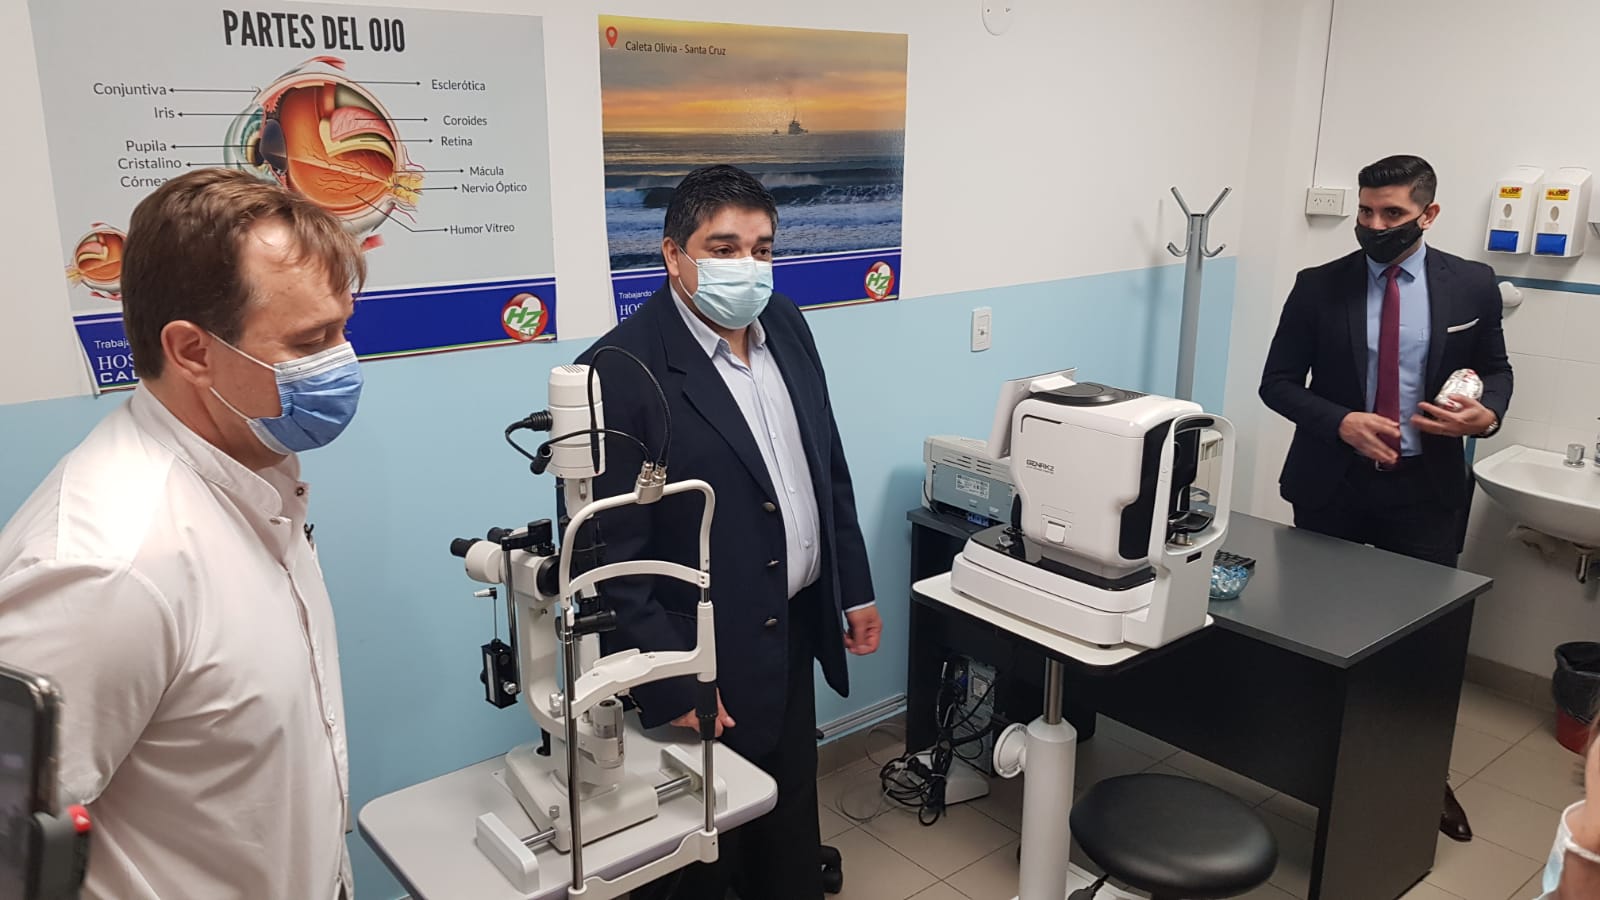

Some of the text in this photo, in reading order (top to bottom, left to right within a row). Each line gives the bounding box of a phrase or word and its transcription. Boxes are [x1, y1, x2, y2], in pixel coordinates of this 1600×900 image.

[222, 9, 406, 53] PARTES DEL OJO
[625, 40, 652, 52] Caleta
[654, 42, 678, 54] Olivia
[684, 44, 707, 55] Santa
[708, 45, 726, 56] Cruz
[93, 82, 167, 97] Conjuntiva
[431, 79, 486, 91] Esclerótica
[153, 106, 175, 119] Iris
[125, 139, 167, 154] Pupila
[440, 135, 473, 146] Retina
[117, 157, 182, 170] Cristalino
[469, 165, 504, 176] Mácula
[461, 180, 528, 194] Nervio Óptico
[449, 224, 483, 235] Humor
[618, 290, 653, 299] Trabajando
[506, 306, 544, 329] HZ
